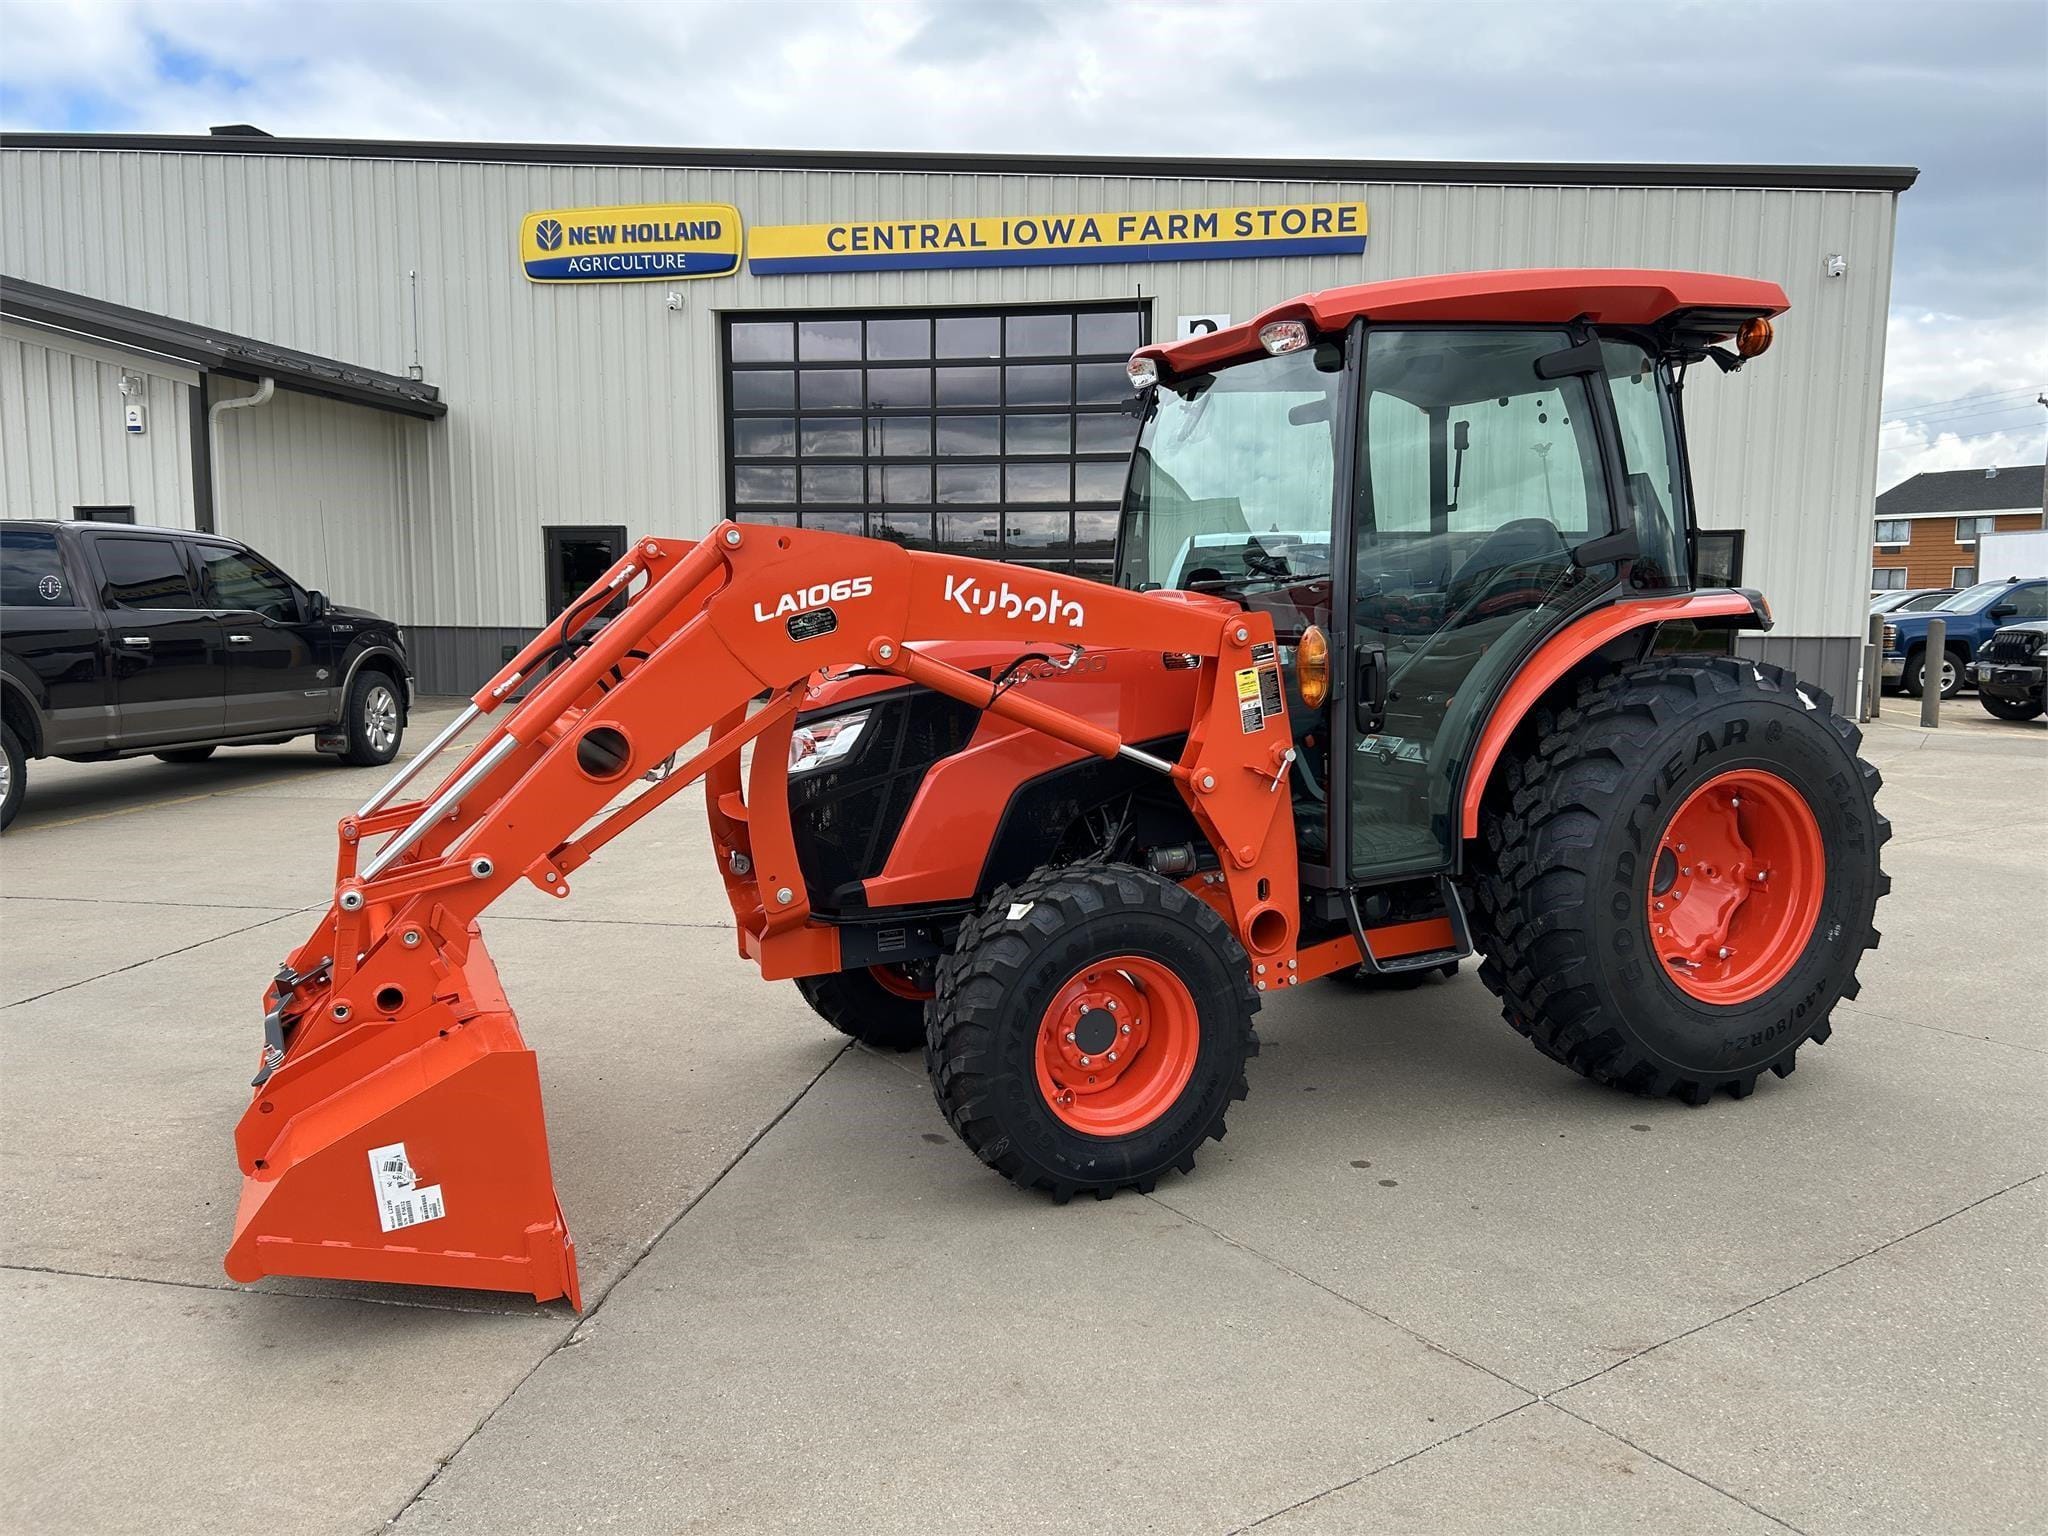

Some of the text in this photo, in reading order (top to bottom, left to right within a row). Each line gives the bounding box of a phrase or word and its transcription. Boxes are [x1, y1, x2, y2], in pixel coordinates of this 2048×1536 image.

[568, 220, 722, 246] NEW HOLLAND
[827, 206, 1357, 252] CENTRAL IOWA FARM STORE
[568, 253, 686, 273] AGRICULTURE
[754, 576, 873, 623] LA1065
[944, 574, 1084, 627] Kubota
[1610, 717, 1749, 989] GOODYEAR
